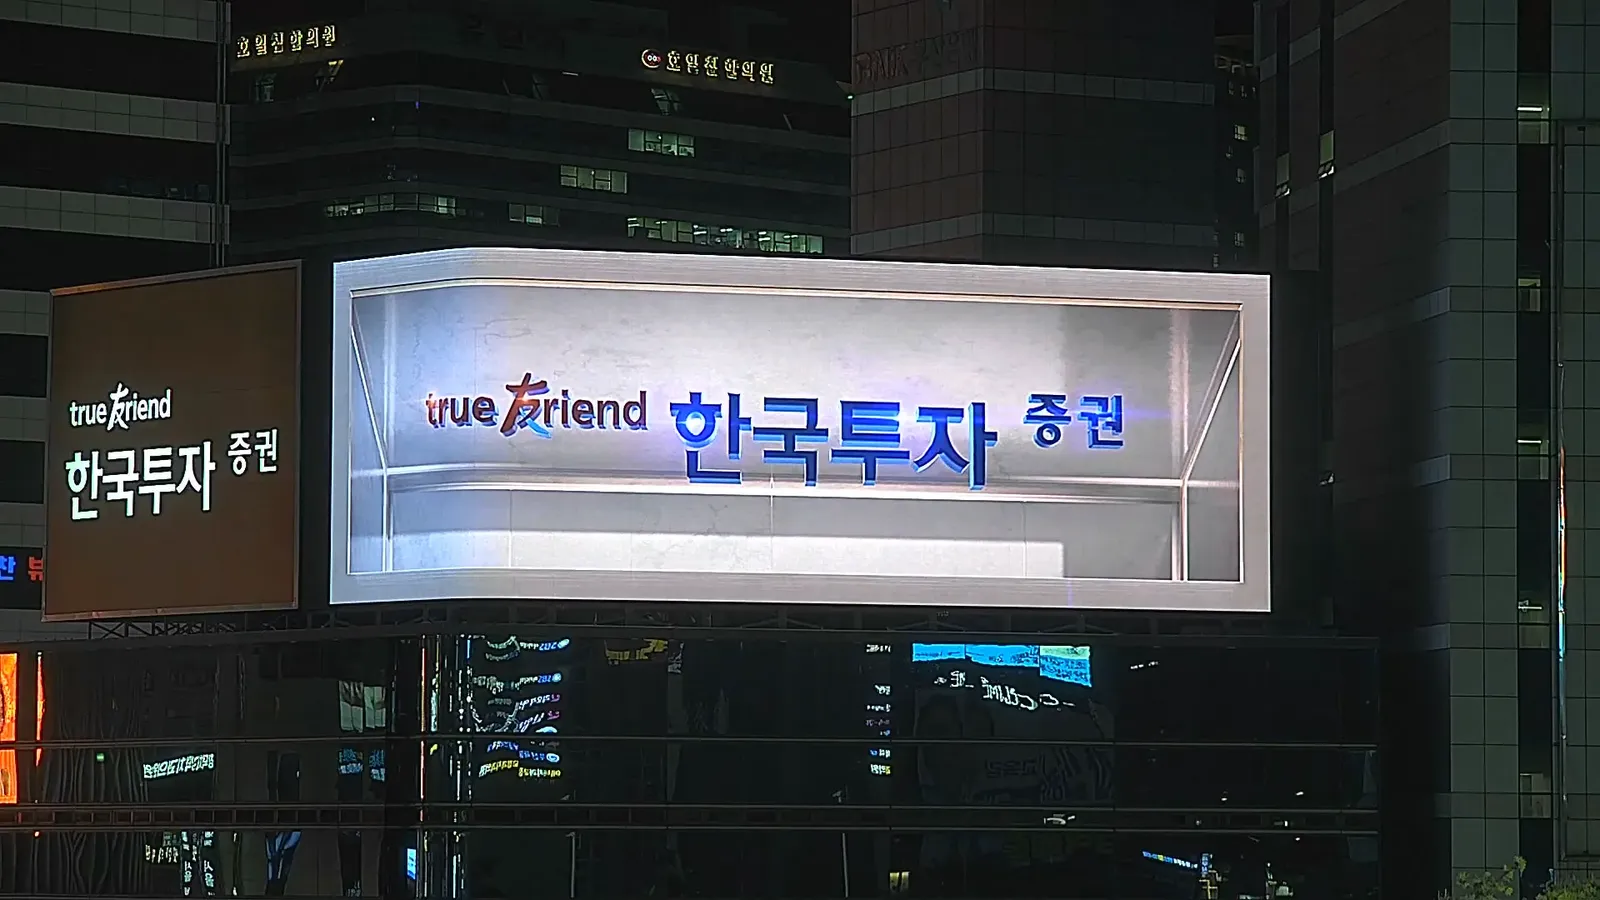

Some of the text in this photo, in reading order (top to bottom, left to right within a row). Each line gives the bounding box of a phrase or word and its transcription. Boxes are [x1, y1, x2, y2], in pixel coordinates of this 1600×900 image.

[69, 400, 107, 427] true
[425, 392, 499, 429] true
[669, 391, 1124, 490] 한국투자 증권
[65, 428, 278, 520] 한국투자 증권
